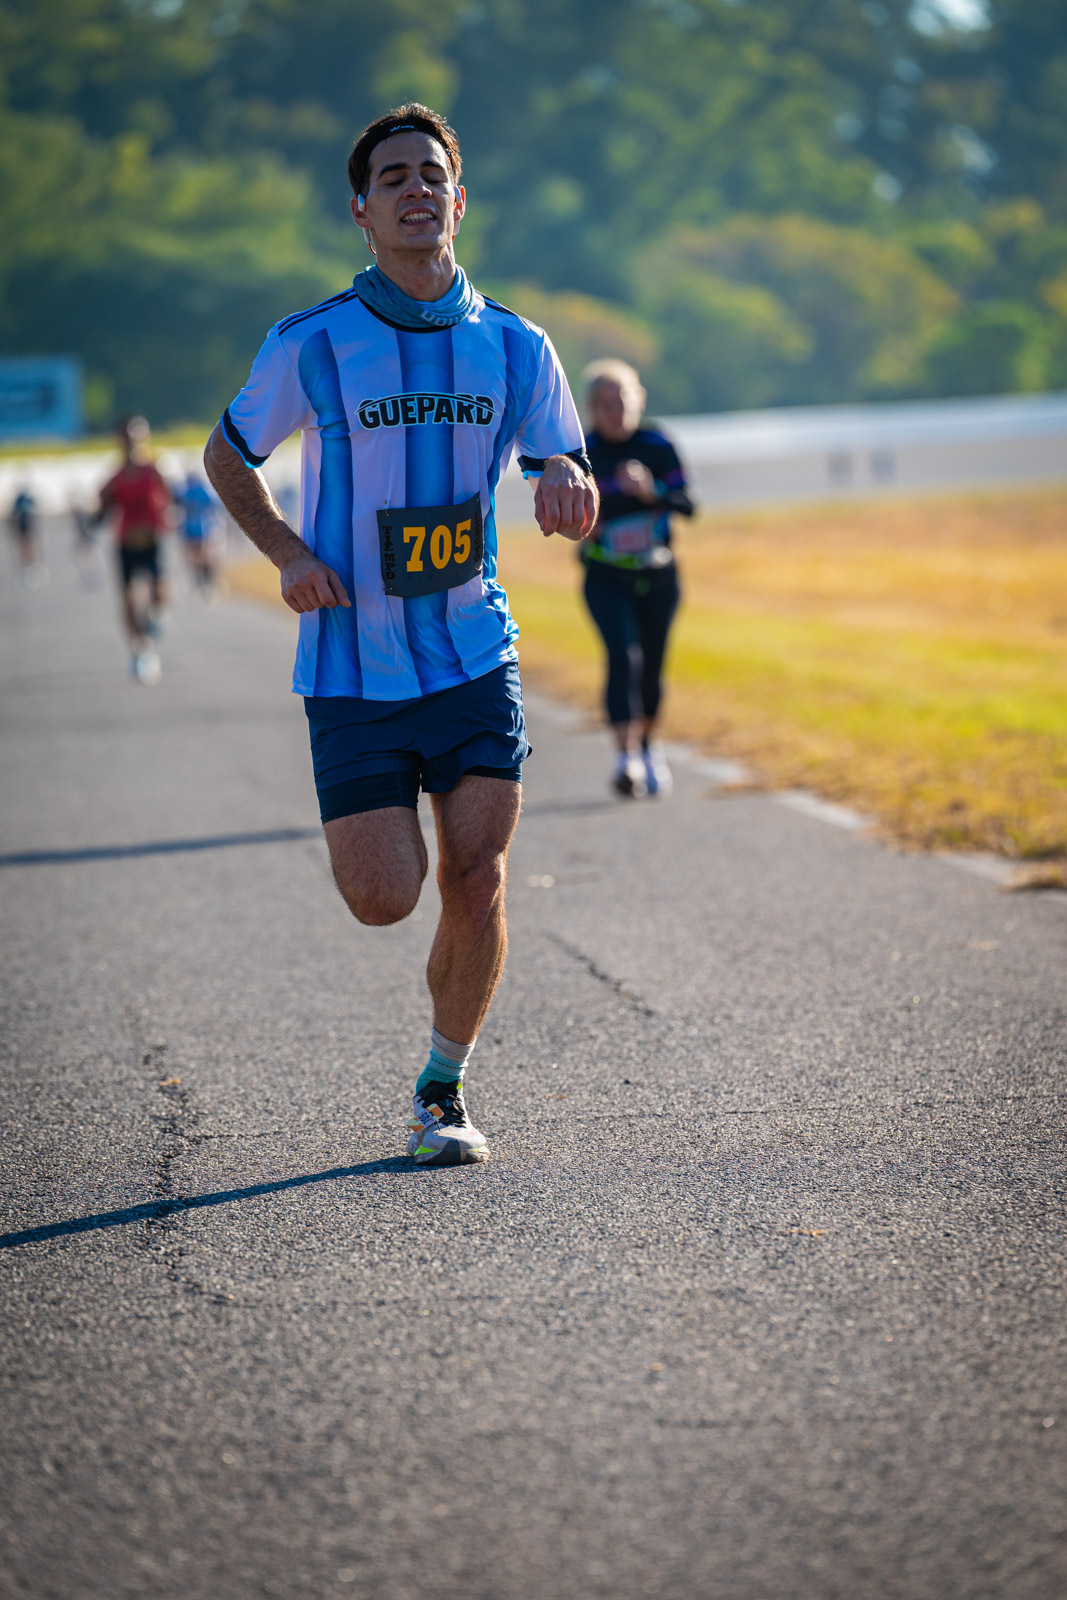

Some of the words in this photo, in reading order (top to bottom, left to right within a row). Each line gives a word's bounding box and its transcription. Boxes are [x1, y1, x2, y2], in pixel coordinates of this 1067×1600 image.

[358, 393, 495, 429] GUEPARD
[382, 525, 396, 580] TIEMPO
[403, 518, 471, 573] 705
[418, 1111, 432, 1125] 705
